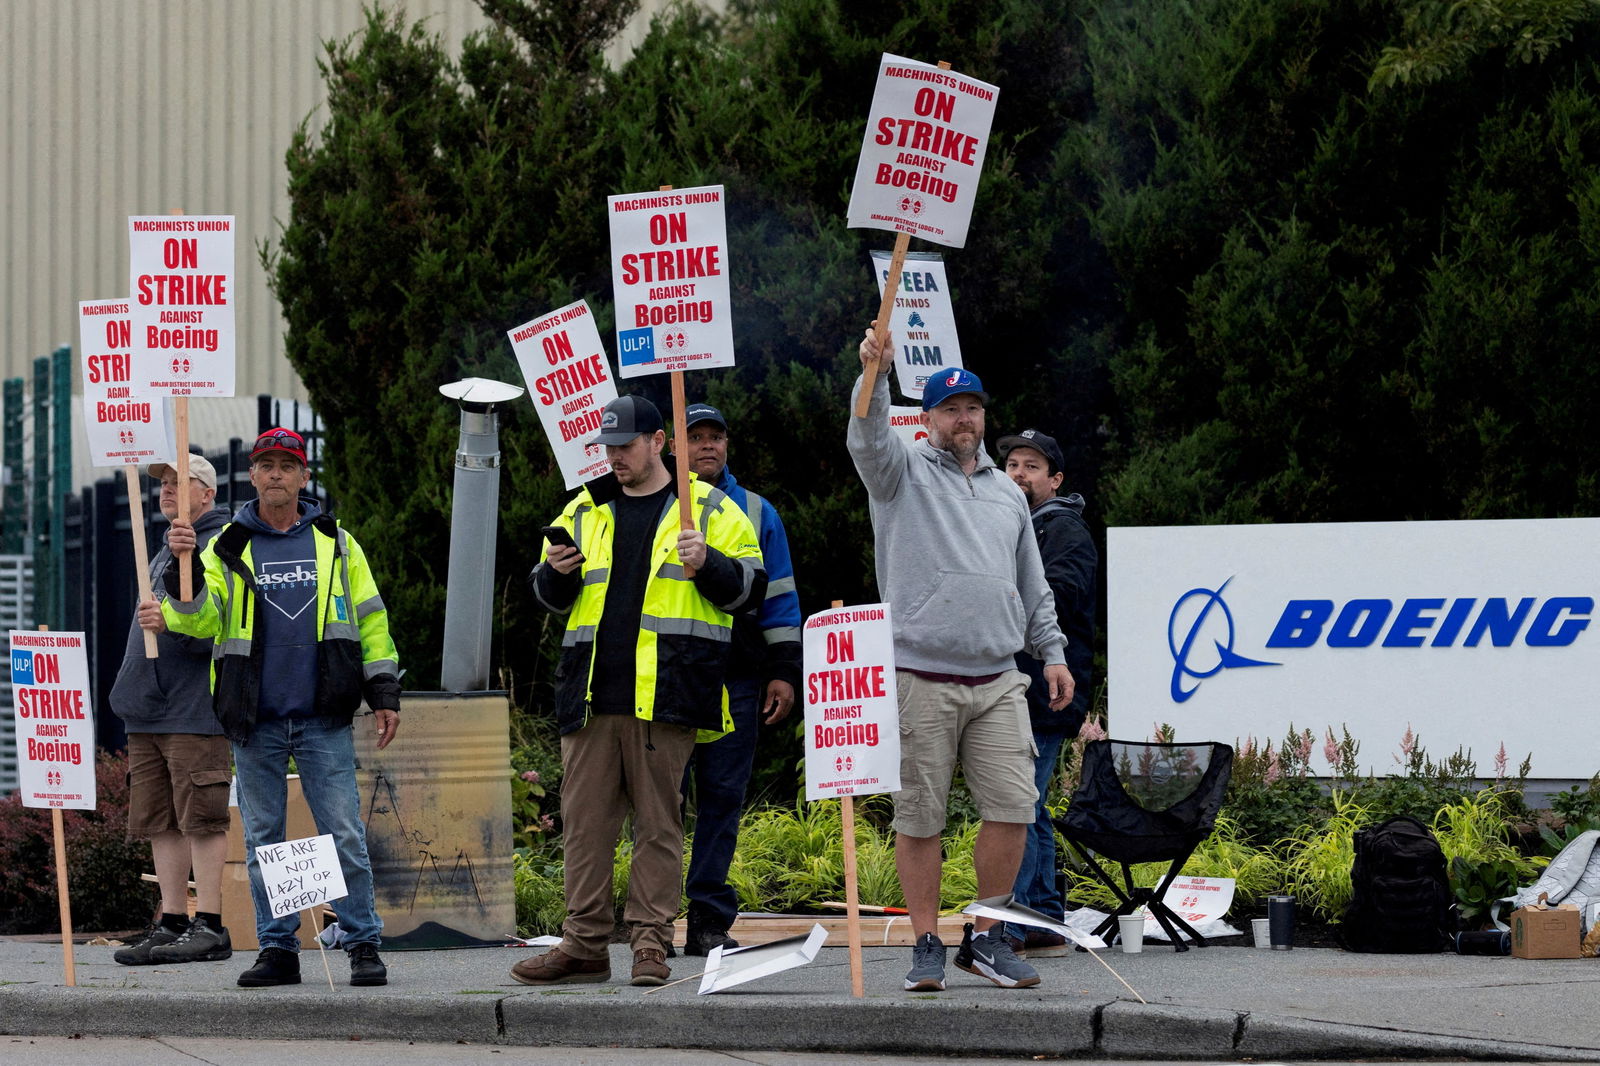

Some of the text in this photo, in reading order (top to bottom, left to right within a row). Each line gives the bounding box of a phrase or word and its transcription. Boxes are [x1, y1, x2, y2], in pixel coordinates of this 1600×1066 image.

[886, 66, 993, 101] MACHINISTS UNION
[914, 87, 956, 123] ON
[875, 117, 979, 166] STRIKE
[896, 152, 947, 173] AGAINST
[875, 162, 958, 203] Boeing
[614, 192, 719, 212] MACHINISTS UNION
[134, 221, 229, 232] MACHINISTS UNION
[650, 212, 687, 246] ON
[894, 216, 918, 228] DISTRICT
[918, 223, 934, 233] LODGE
[895, 223, 916, 234] AFL-CIO
[163, 238, 198, 269] ON
[621, 246, 720, 285] STRIKE
[138, 275, 227, 305] STRIKE
[649, 284, 695, 301] AGAINST
[882, 270, 939, 292] EEA
[83, 304, 129, 315] MACHINISTS
[635, 300, 712, 328] Boeing
[896, 298, 930, 308] STANDS
[160, 311, 203, 323] AGAINST
[514, 304, 587, 343] MACHINISTS UNION
[106, 320, 130, 349] ON
[147, 325, 218, 352] Boeing
[623, 336, 650, 352] ULP!
[907, 331, 929, 340] WITH
[542, 330, 574, 366] ON
[903, 345, 943, 366] IAM
[88, 354, 130, 383] STRI
[667, 362, 687, 370] AFL-CIO
[535, 353, 608, 406] STRIKE
[107, 387, 130, 399] AGAIN
[561, 393, 594, 416] AGAINST
[97, 400, 151, 423] Boeing
[889, 415, 920, 426] ACHIN
[255, 566, 318, 585] aseba
[806, 609, 884, 629] MACHINISTS UNION
[1265, 596, 1594, 648] BOEING
[13, 636, 81, 647] MACHINISTS UNION
[826, 630, 855, 665] ON
[14, 658, 32, 672] ULP!
[34, 653, 60, 683] ON
[808, 665, 886, 705] STRIKE
[18, 688, 85, 719] STRIKE
[824, 705, 863, 722] AGAINST
[36, 724, 68, 737] AGAINST
[815, 722, 879, 749] Boeing
[28, 738, 81, 765] Boeing
[258, 839, 318, 864] WE ARE
[285, 857, 317, 874] NOT
[268, 871, 333, 899] LAZY OR
